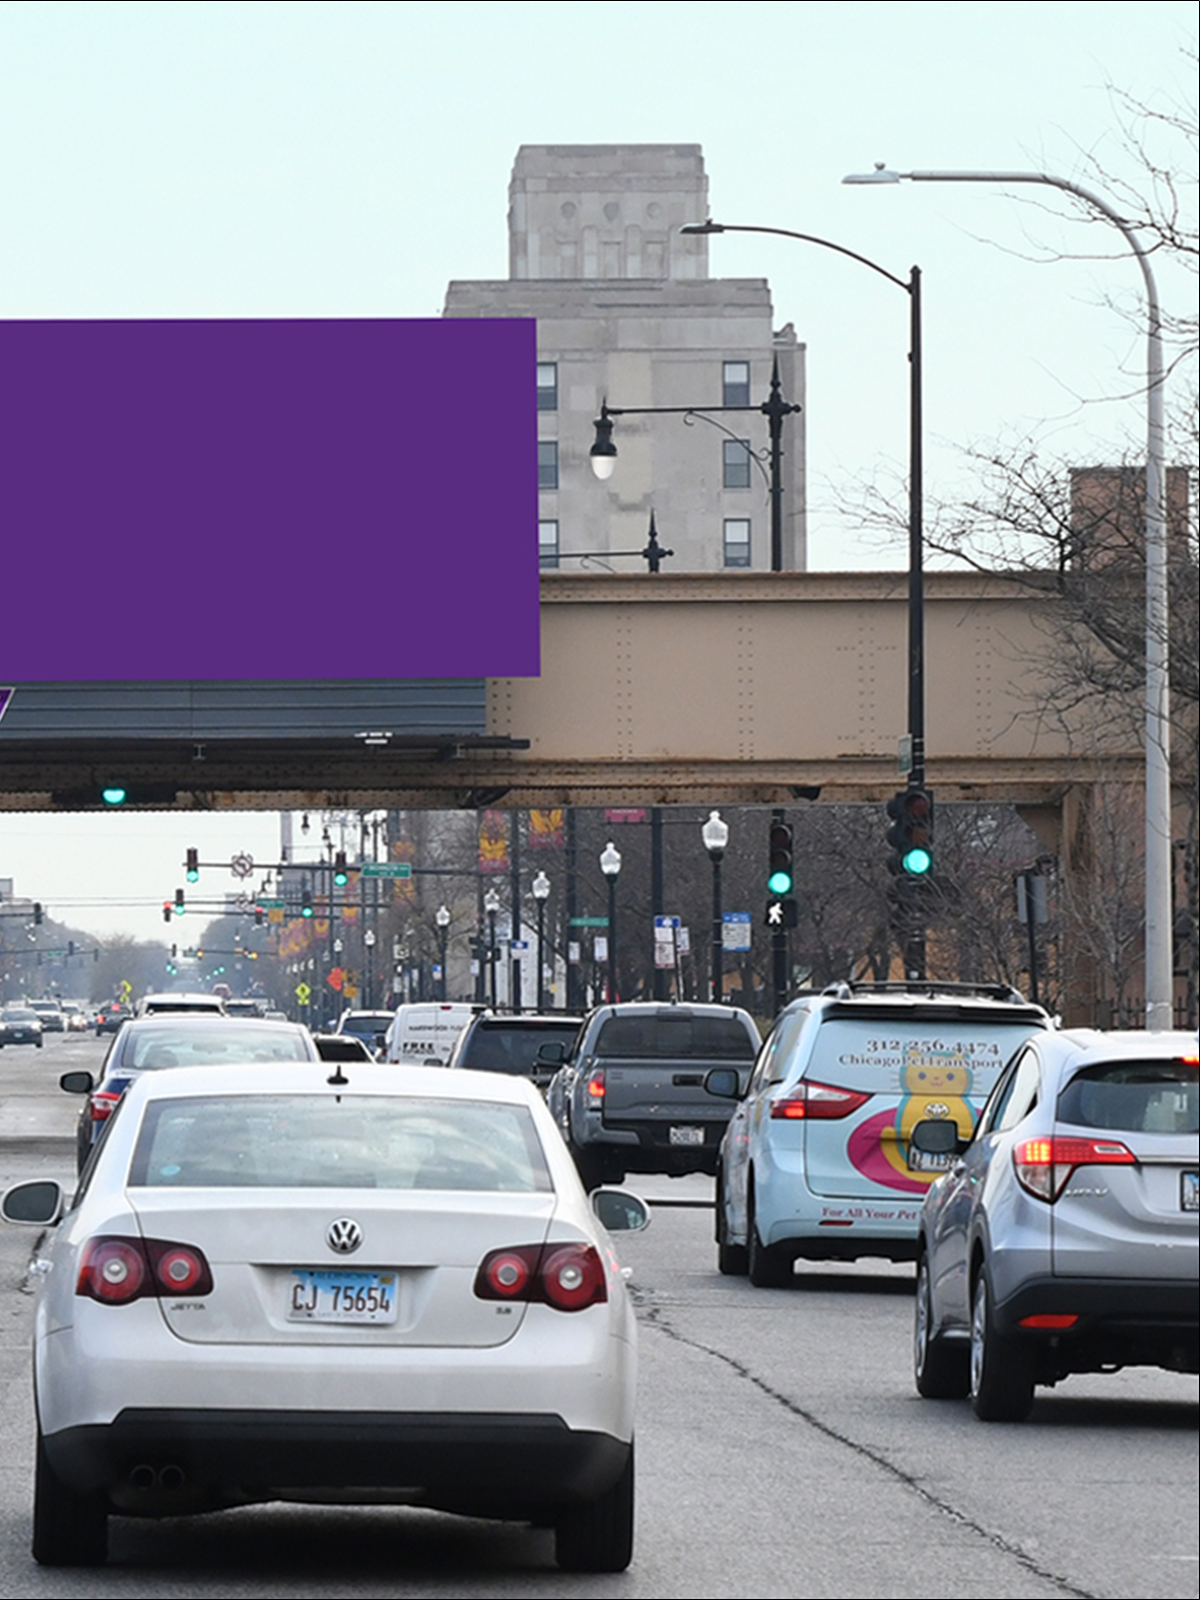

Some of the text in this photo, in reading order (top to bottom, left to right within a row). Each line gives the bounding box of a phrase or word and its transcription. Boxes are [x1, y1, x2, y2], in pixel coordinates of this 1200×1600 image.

[402, 1042, 434, 1050] FREE
[866, 1038, 1000, 1056] 312.256.4474
[822, 1206, 918, 1220] For All Your Pet
[292, 1283, 391, 1313] CJ 75654
[170, 1302, 206, 1311] JETTA
